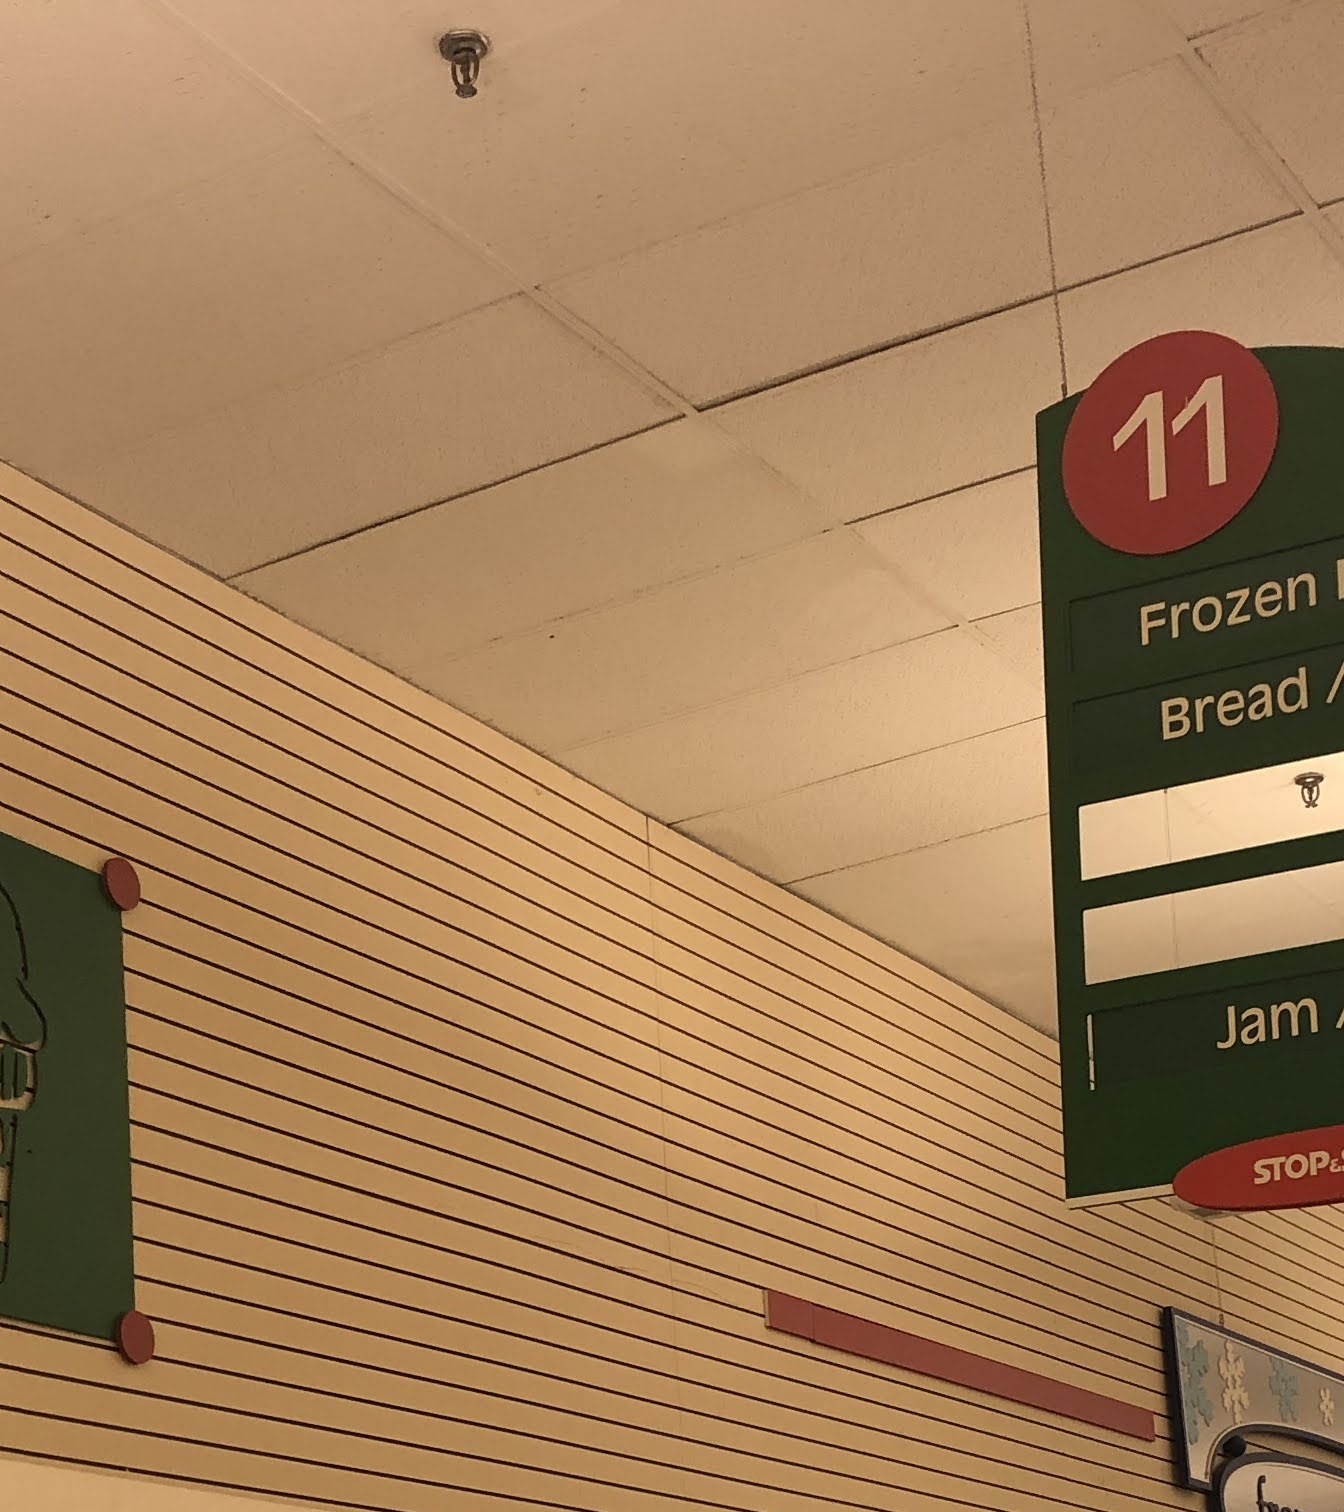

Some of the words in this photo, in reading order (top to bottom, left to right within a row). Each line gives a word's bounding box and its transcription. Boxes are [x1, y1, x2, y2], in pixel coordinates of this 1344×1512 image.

[1113, 373, 1229, 503] 11
[1139, 570, 1317, 648] Frozen
[1160, 658, 1310, 741] Bread
[1216, 993, 1320, 1052] Jam
